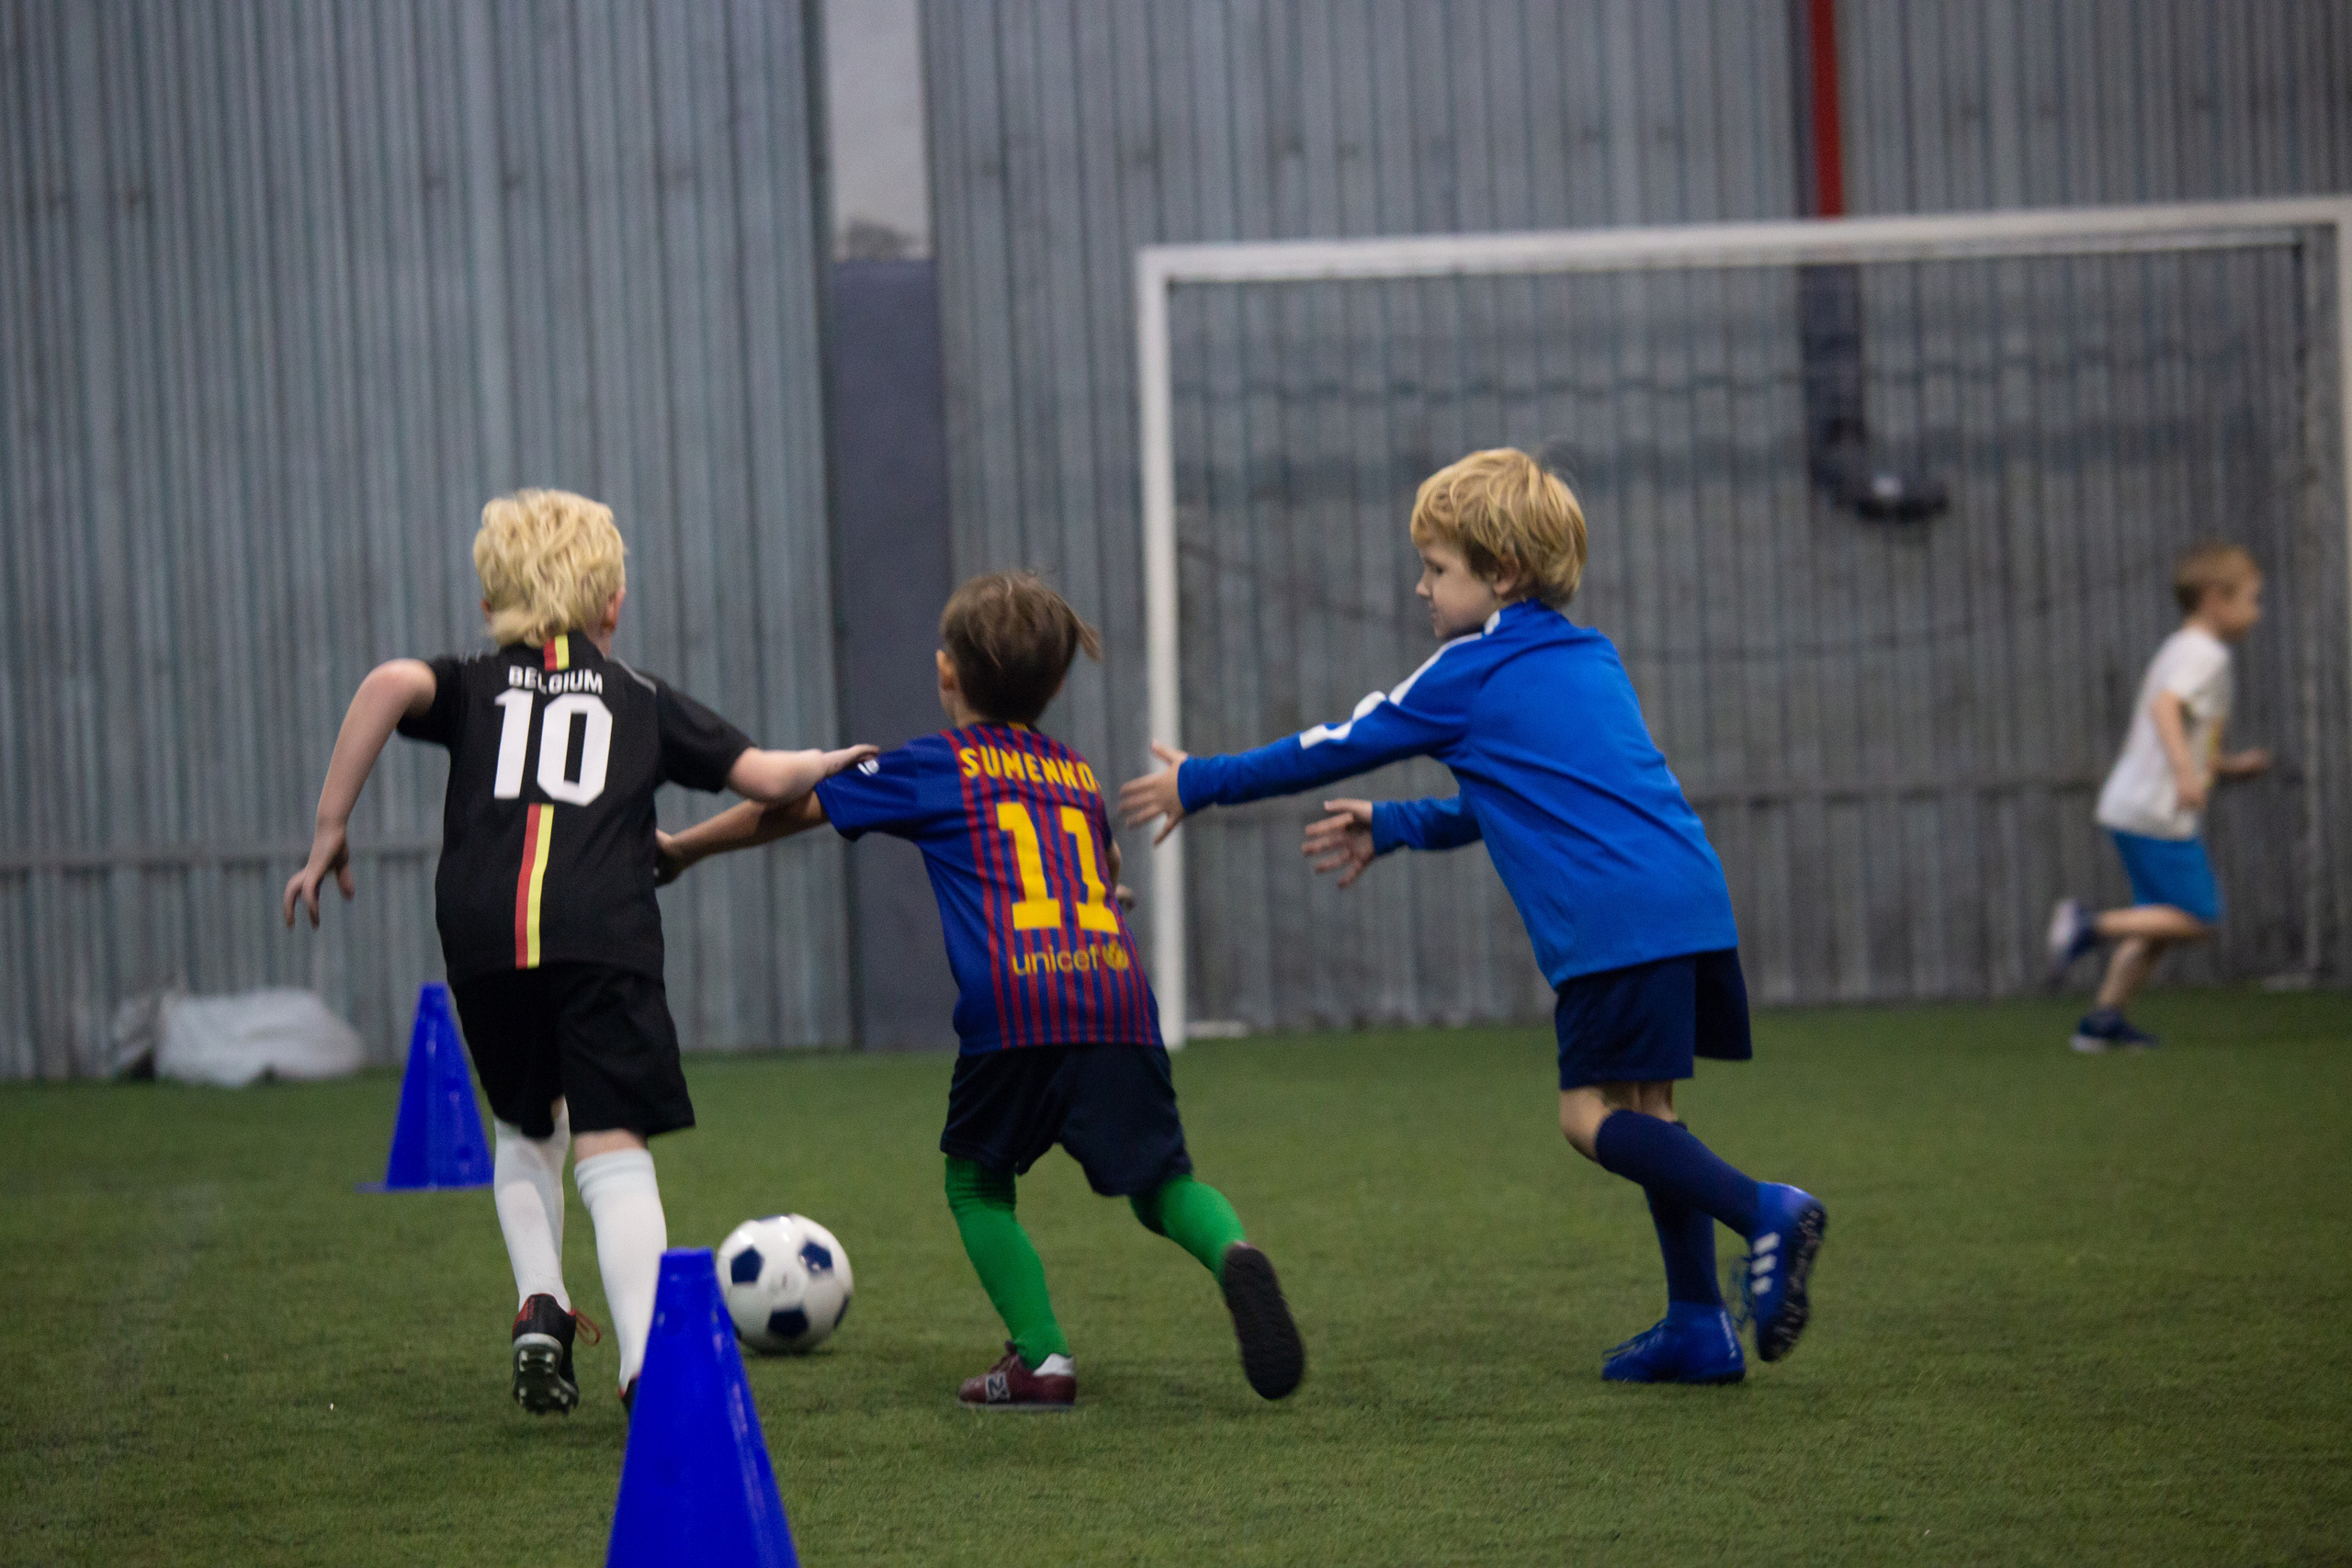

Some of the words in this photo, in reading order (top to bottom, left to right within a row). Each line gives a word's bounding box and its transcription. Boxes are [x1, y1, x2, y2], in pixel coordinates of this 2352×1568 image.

[507, 665, 603, 695] BELGIUM
[493, 687, 614, 807] 10
[958, 745, 1100, 794] SUMENKO
[996, 801, 1120, 935] 11
